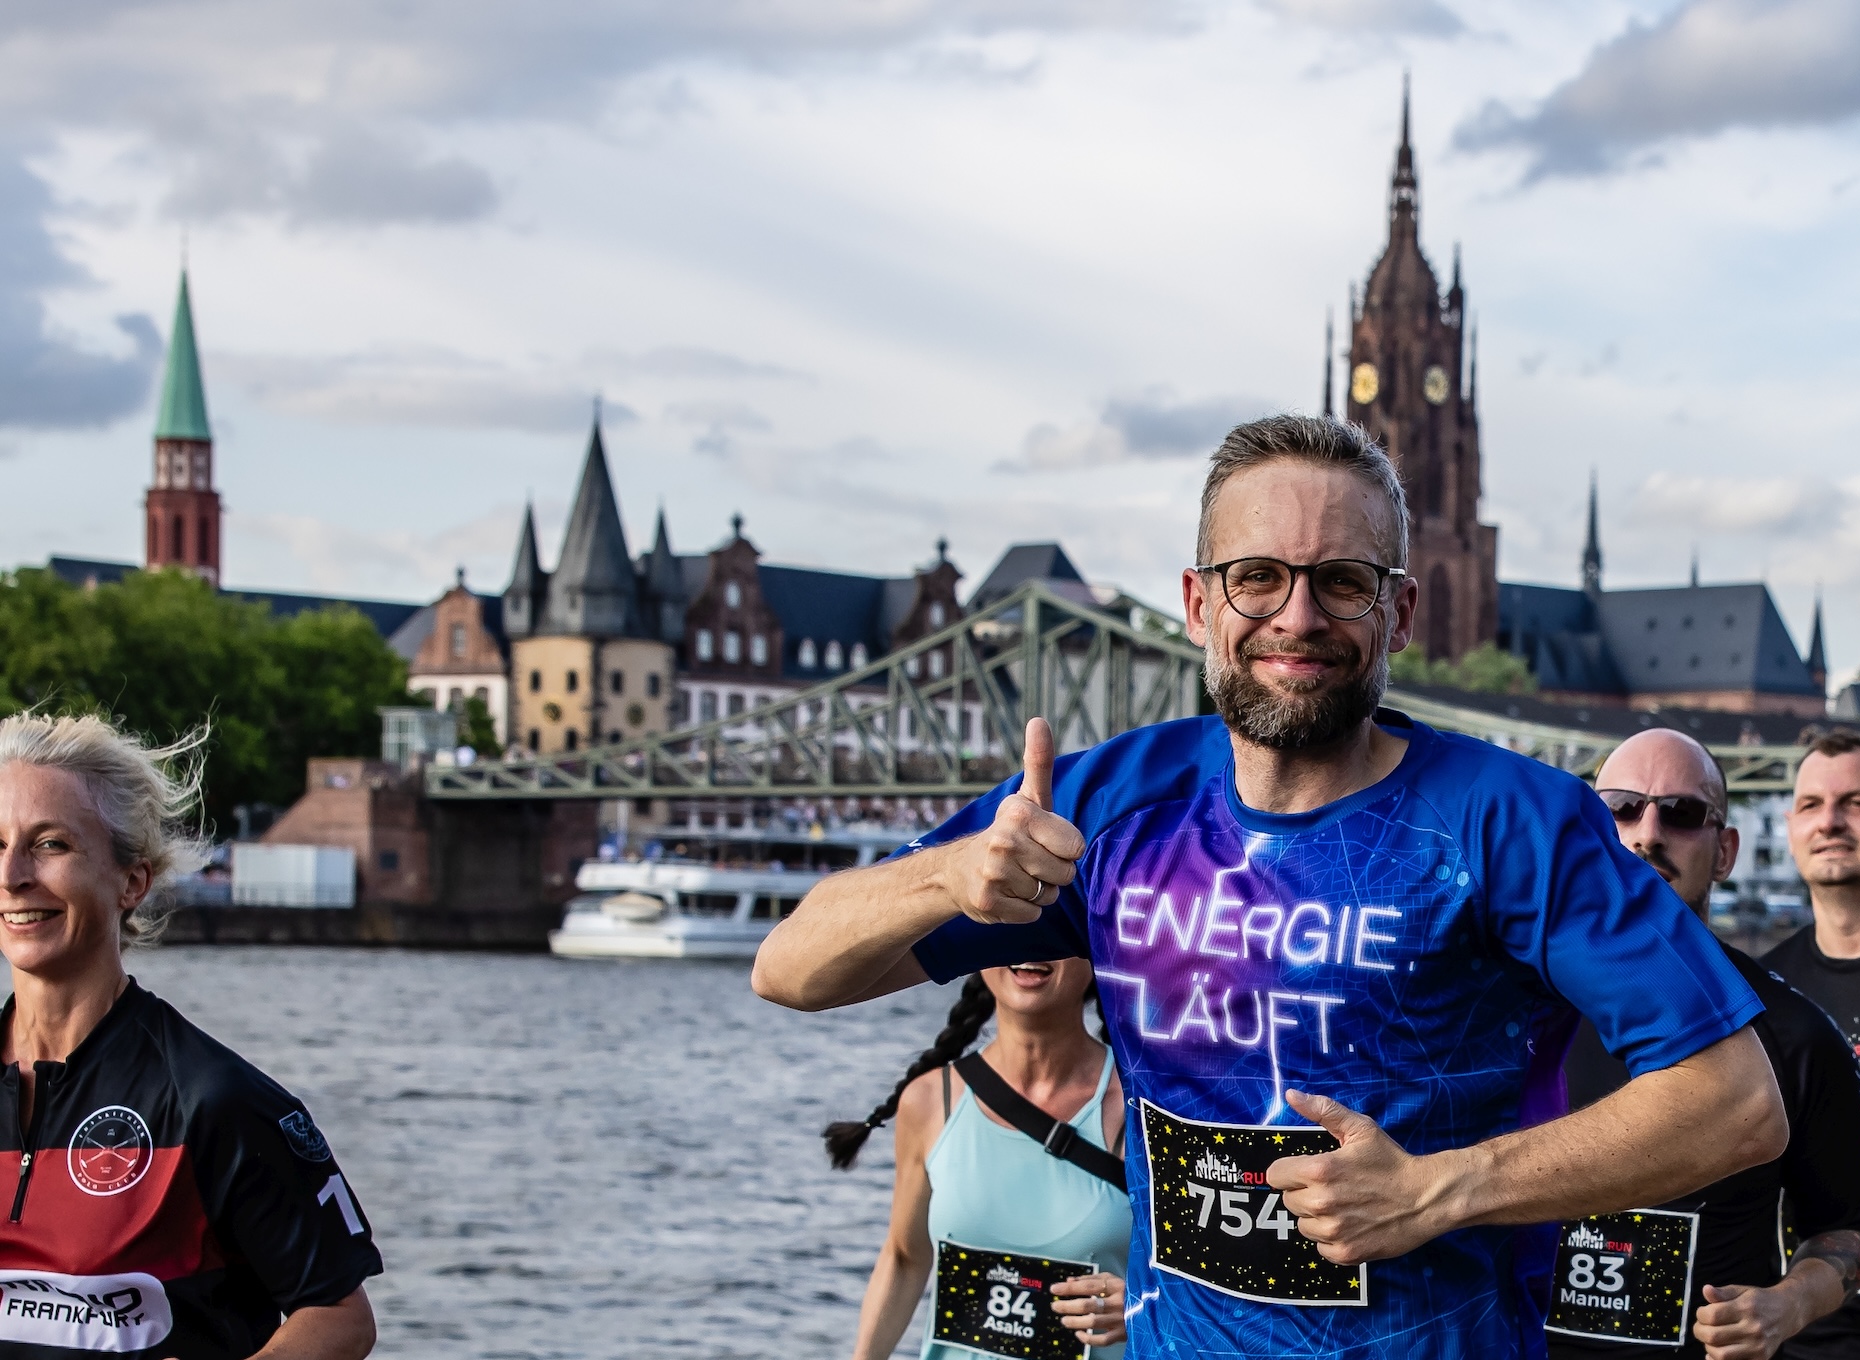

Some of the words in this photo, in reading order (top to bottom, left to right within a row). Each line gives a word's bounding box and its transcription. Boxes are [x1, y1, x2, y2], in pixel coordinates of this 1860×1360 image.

[1244, 1171, 1267, 1185] RU
[317, 1172, 364, 1236] 1
[1186, 1179, 1295, 1240] 754
[1607, 1241, 1633, 1253] RUN
[1567, 1253, 1625, 1292] 83
[986, 1284, 1037, 1324] 84
[1560, 1288, 1631, 1312] Manuel
[982, 1315, 1035, 1338] Asako
